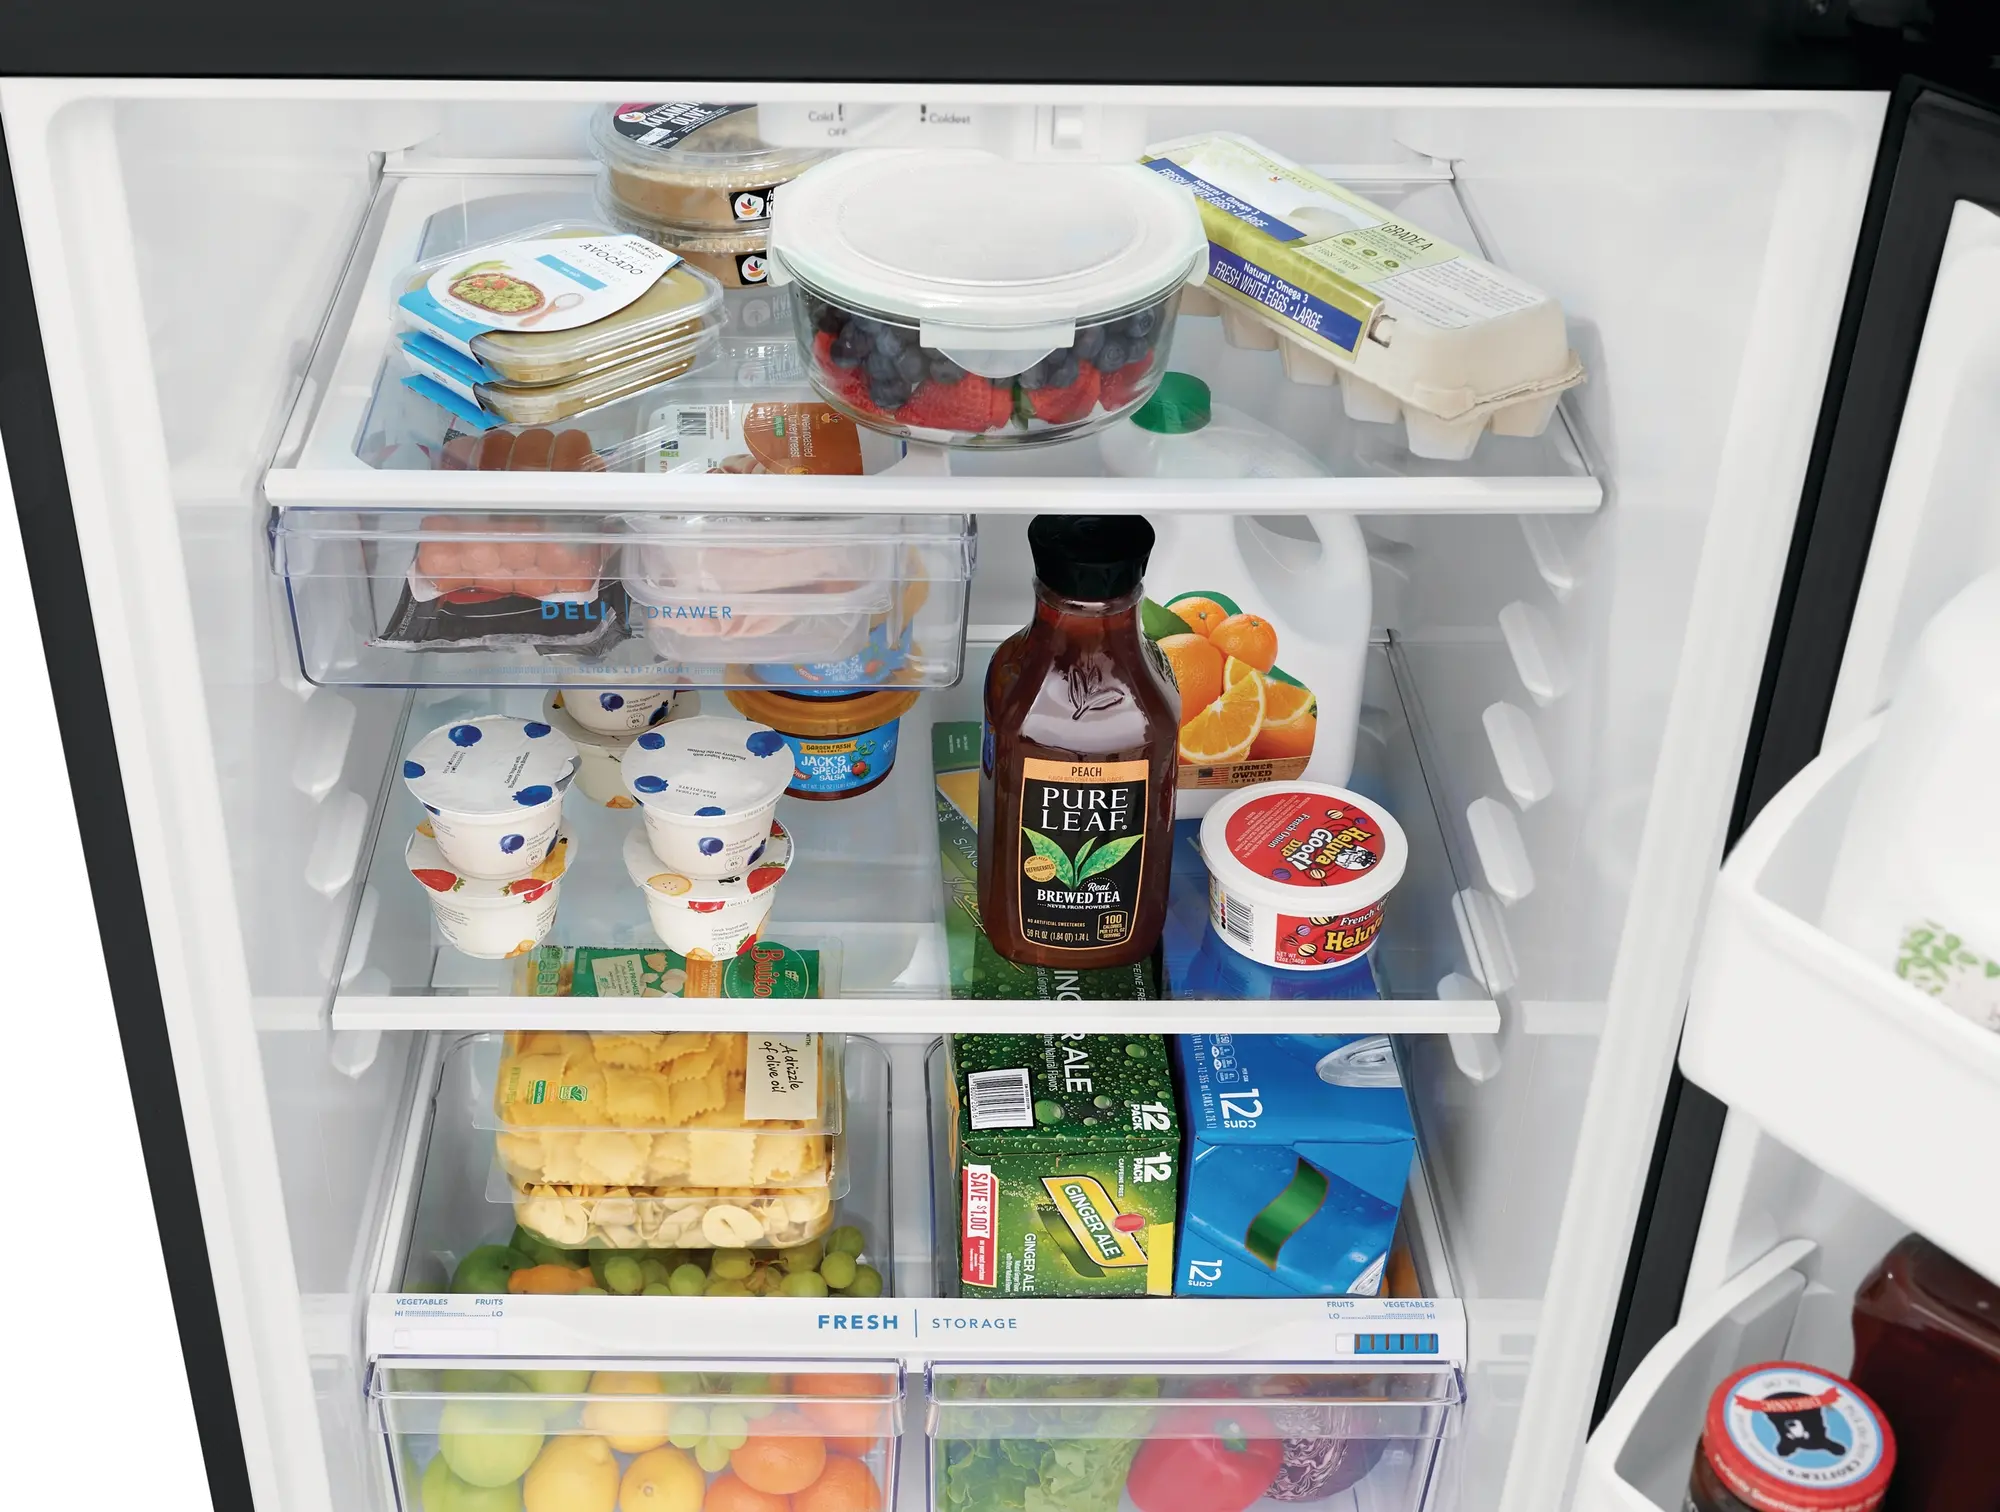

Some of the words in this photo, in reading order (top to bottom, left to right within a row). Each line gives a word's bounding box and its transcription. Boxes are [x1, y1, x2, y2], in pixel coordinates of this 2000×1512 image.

[670, 107, 713, 126] OLIVE
[808, 110, 834, 122] Cold
[929, 112, 971, 124] Coldest
[827, 128, 848, 137] OFF
[1193, 179, 1223, 197] Natural
[1226, 196, 1251, 212] Omega
[1236, 210, 1268, 228] LARGE
[1381, 224, 1427, 246] GRADE
[578, 243, 643, 275] AVOCADO
[1243, 262, 1271, 284] Natural
[1275, 280, 1302, 300] Omega
[1302, 293, 1309, 304] 3
[1213, 260, 1241, 287] FRESH
[1239, 273, 1268, 301] WHITE
[1264, 288, 1290, 313] EGGS
[1292, 303, 1323, 331] LARGE
[803, 431, 816, 458] roasted
[541, 600, 606, 620] DELI
[647, 606, 732, 619] DRAWER
[801, 756, 846, 767] JACK'S
[812, 765, 852, 775] SPECIAL
[1232, 763, 1273, 772] FARMER
[819, 774, 845, 782] SALSA
[1071, 766, 1102, 777] PEACH
[1232, 770, 1272, 779] OWNED
[1042, 787, 1129, 809] PURE
[1286, 813, 1311, 833] French
[1268, 830, 1290, 849] Onion
[1281, 838, 1304, 858] DIP
[1315, 826, 1374, 866] Heluva
[1287, 828, 1335, 872] Good!
[1025, 863, 1055, 873] REFRIGERATED
[1037, 888, 1093, 904] BREWED
[1096, 890, 1120, 903] TEA
[1088, 882, 1111, 892] Real
[1034, 919, 1057, 927] ARTIFICIAL
[1105, 914, 1122, 924] 100
[1340, 911, 1374, 927] French
[1026, 929, 1034, 937] 59
[1034, 929, 1040, 938] FL
[1041, 931, 1048, 939] OZ
[1050, 932, 1063, 941] (1.84
[1064, 932, 1074, 942] QT)
[1074, 933, 1085, 941] 1.74
[627, 960, 635, 972] OUR
[750, 945, 784, 998] Buito
[630, 973, 640, 996] PROMISE
[759, 1041, 779, 1054] of
[779, 1043, 798, 1054] A
[766, 1055, 781, 1078] olive
[1045, 1047, 1058, 1069] Natural
[784, 1055, 804, 1090] drizzle
[1062, 1046, 1092, 1093] ALE
[771, 1080, 787, 1093] oil
[1048, 1069, 1059, 1092] Flavors
[1202, 1093, 1213, 1109] CANS
[1220, 1088, 1263, 1119] 12
[1131, 1103, 1144, 1130] PACK
[1141, 1101, 1171, 1131] 12
[1223, 1119, 1257, 1129] cans
[1133, 1157, 1144, 1183] PACK
[1144, 1151, 1172, 1183] 12
[970, 1172, 988, 1202] SAVE
[1064, 1184, 1101, 1232] GINGER
[1094, 1226, 1121, 1258] ALE
[1024, 1233, 1036, 1272] GINGER
[1188, 1259, 1223, 1282] 12
[1023, 1273, 1035, 1292] ALE
[1188, 1278, 1213, 1288] cans
[396, 1298, 448, 1306] VEGETABLES
[475, 1298, 503, 1306] FRUITS
[817, 1314, 899, 1330] FRESH
[932, 1317, 1018, 1329] STORAGE
